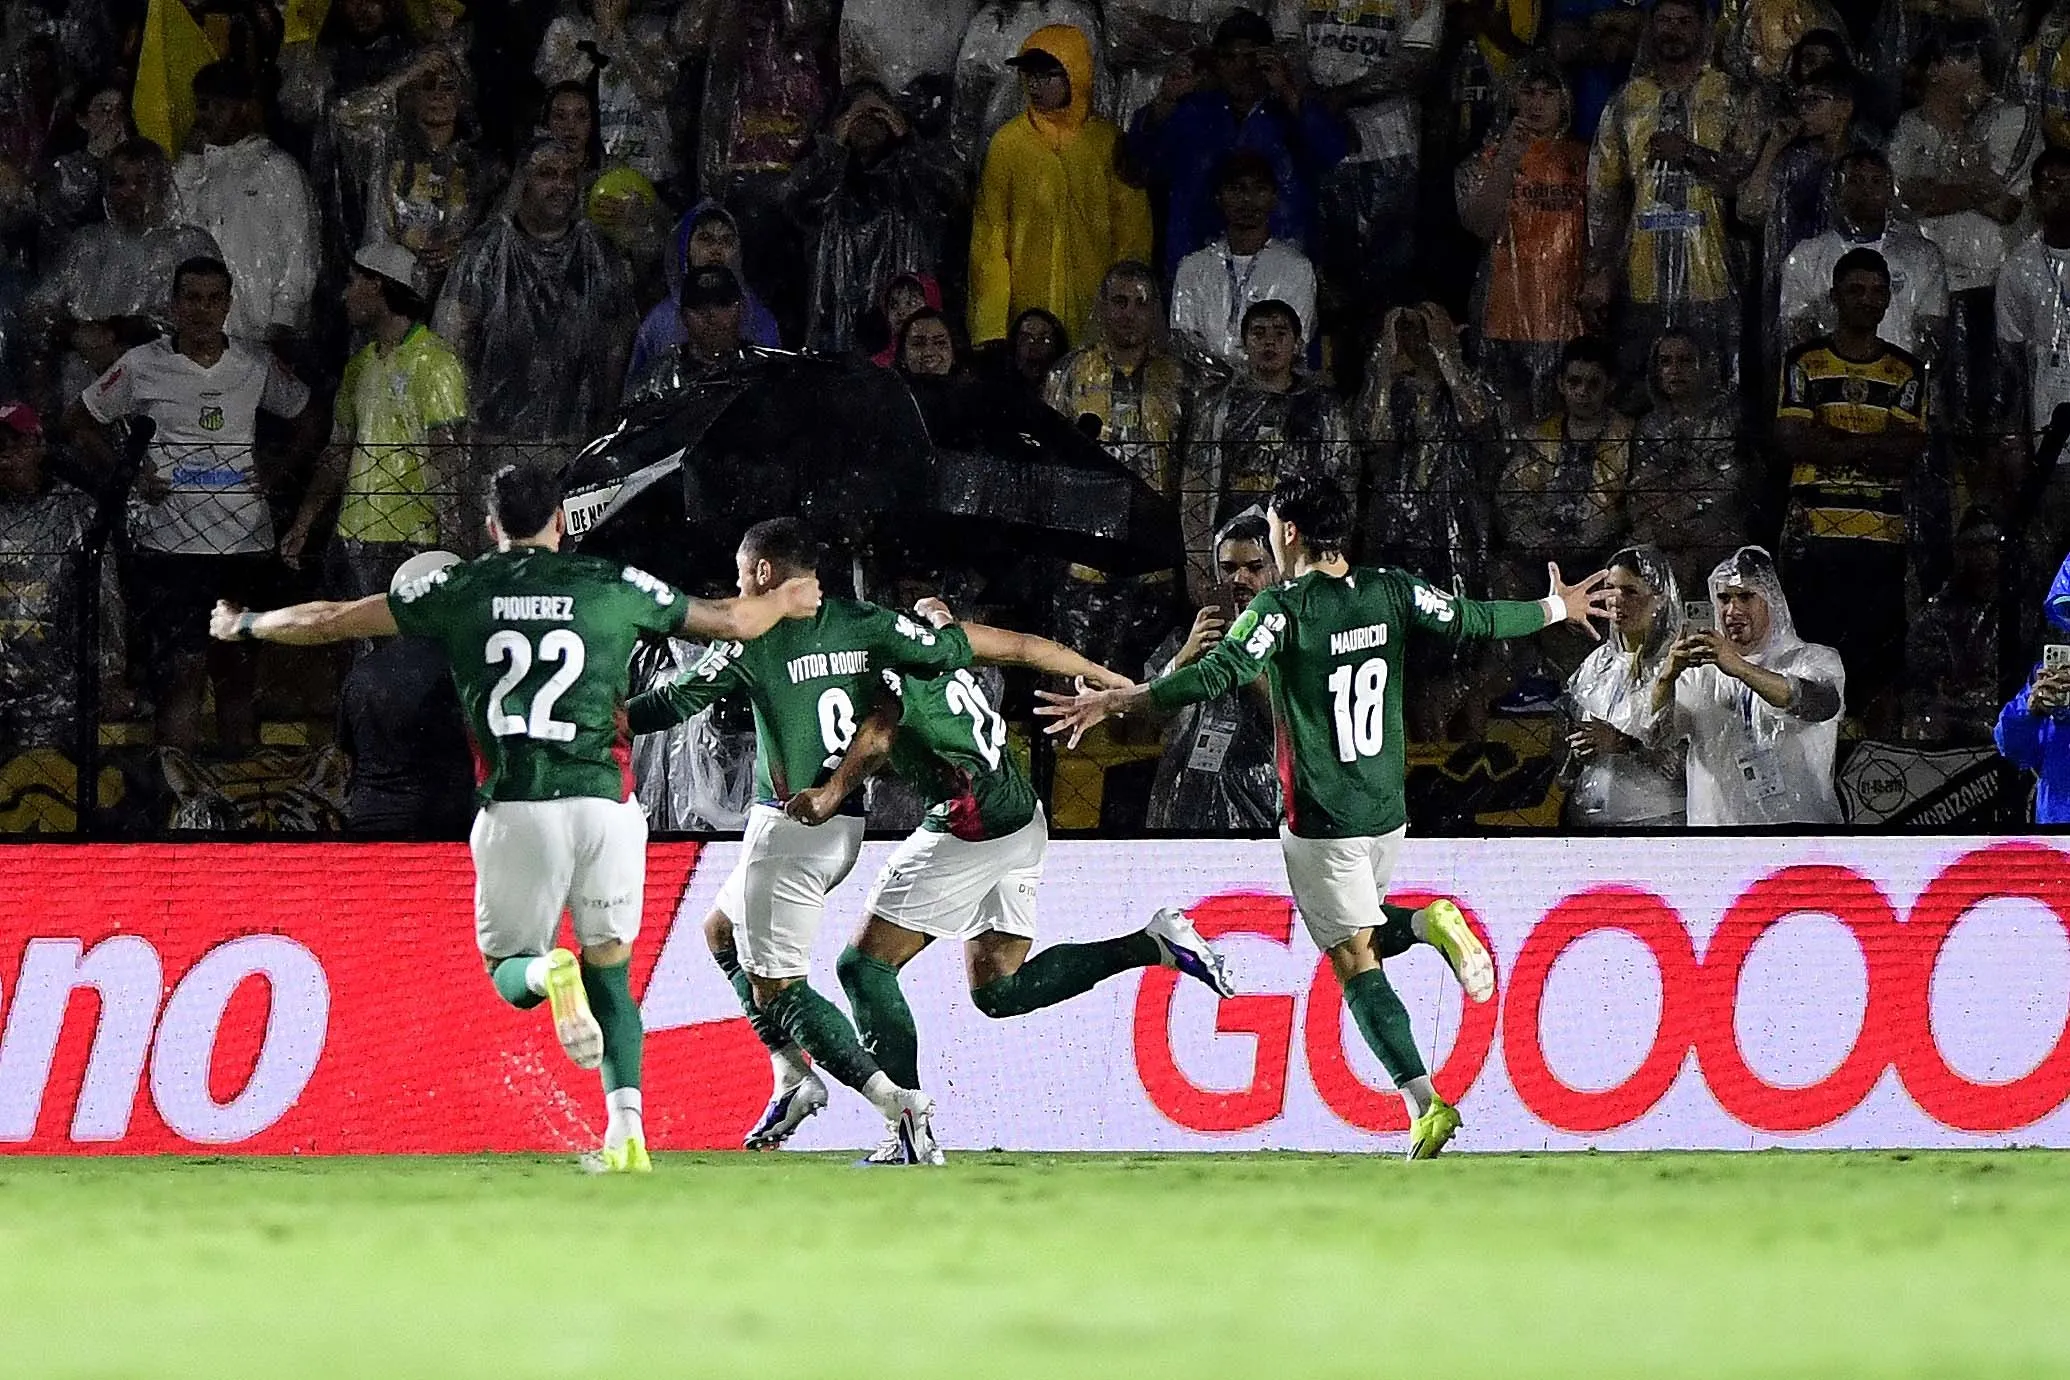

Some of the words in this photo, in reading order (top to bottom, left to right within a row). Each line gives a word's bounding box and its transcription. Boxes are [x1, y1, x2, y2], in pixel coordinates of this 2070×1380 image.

[571, 508, 588, 532] DE
[492, 595, 575, 622] PIQUEREZ
[1330, 623, 1388, 656] MAURICIO
[787, 653, 829, 684] VITOR
[829, 650, 870, 675] ROQUE
[485, 628, 585, 743] 22
[1328, 657, 1388, 763] 18
[0, 934, 331, 1144] no
